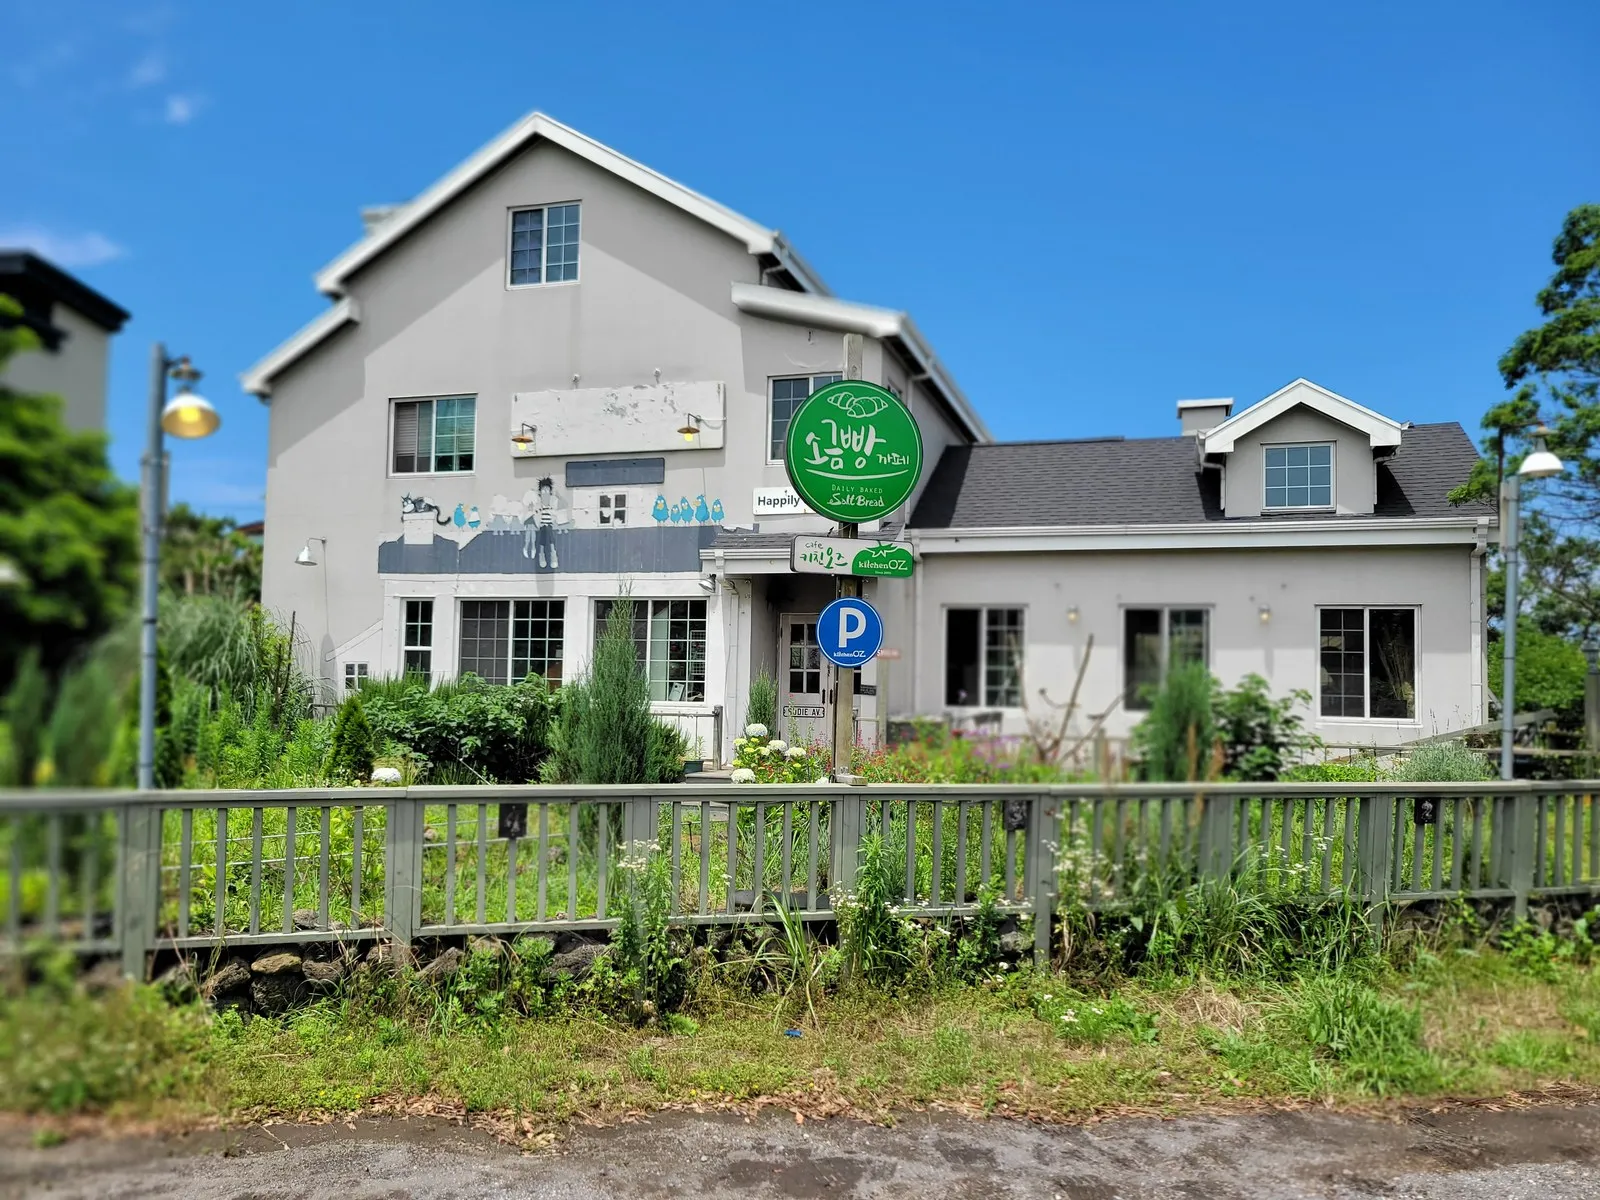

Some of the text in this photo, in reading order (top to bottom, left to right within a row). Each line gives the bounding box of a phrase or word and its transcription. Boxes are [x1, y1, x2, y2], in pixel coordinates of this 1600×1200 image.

[804, 419, 887, 470] 소금빵
[831, 484, 883, 494] DAILY BAKED
[757, 495, 801, 508] Happily
[827, 492, 885, 507] Salt Bread
[838, 607, 867, 648] P
